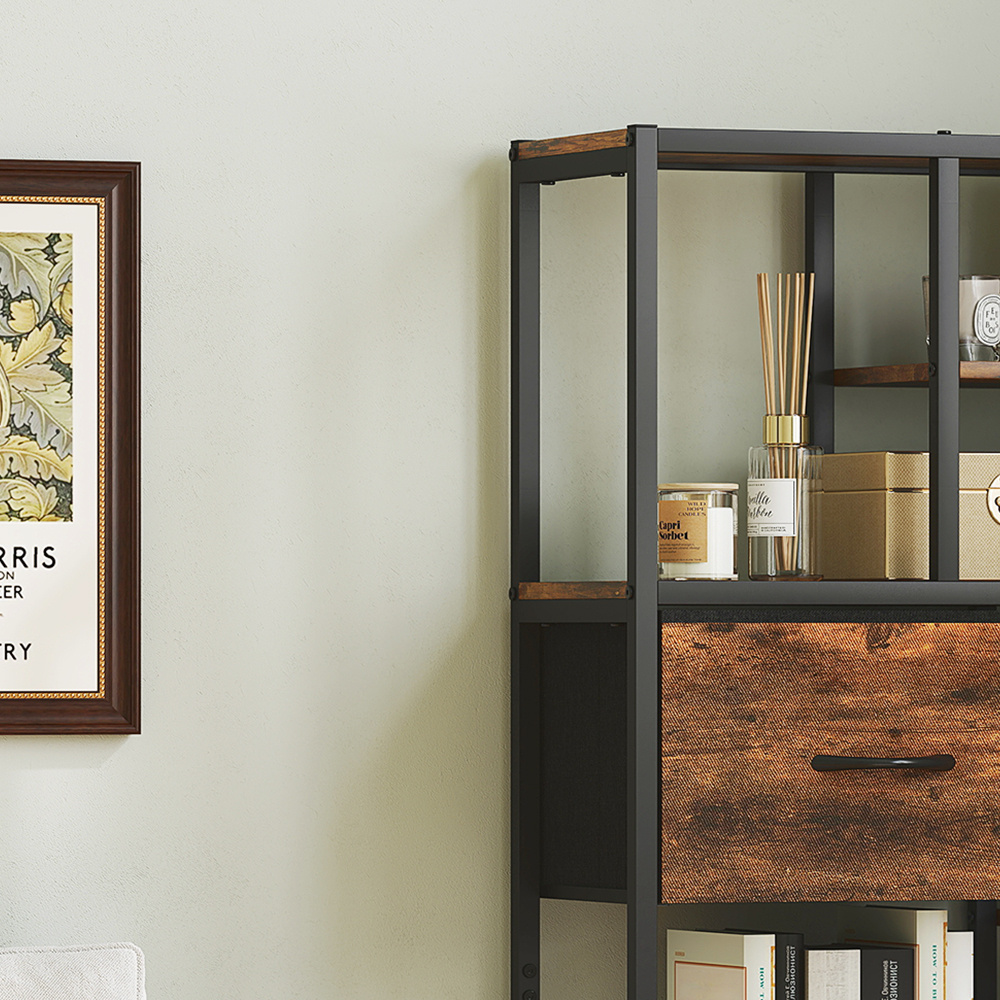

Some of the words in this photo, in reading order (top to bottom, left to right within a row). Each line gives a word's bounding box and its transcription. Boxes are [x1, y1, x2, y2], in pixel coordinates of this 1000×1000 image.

[659, 520, 681, 531] Capri
[0, 585, 24, 599] ER
[0, 643, 32, 661] RY
[932, 971, 937, 985] TO
